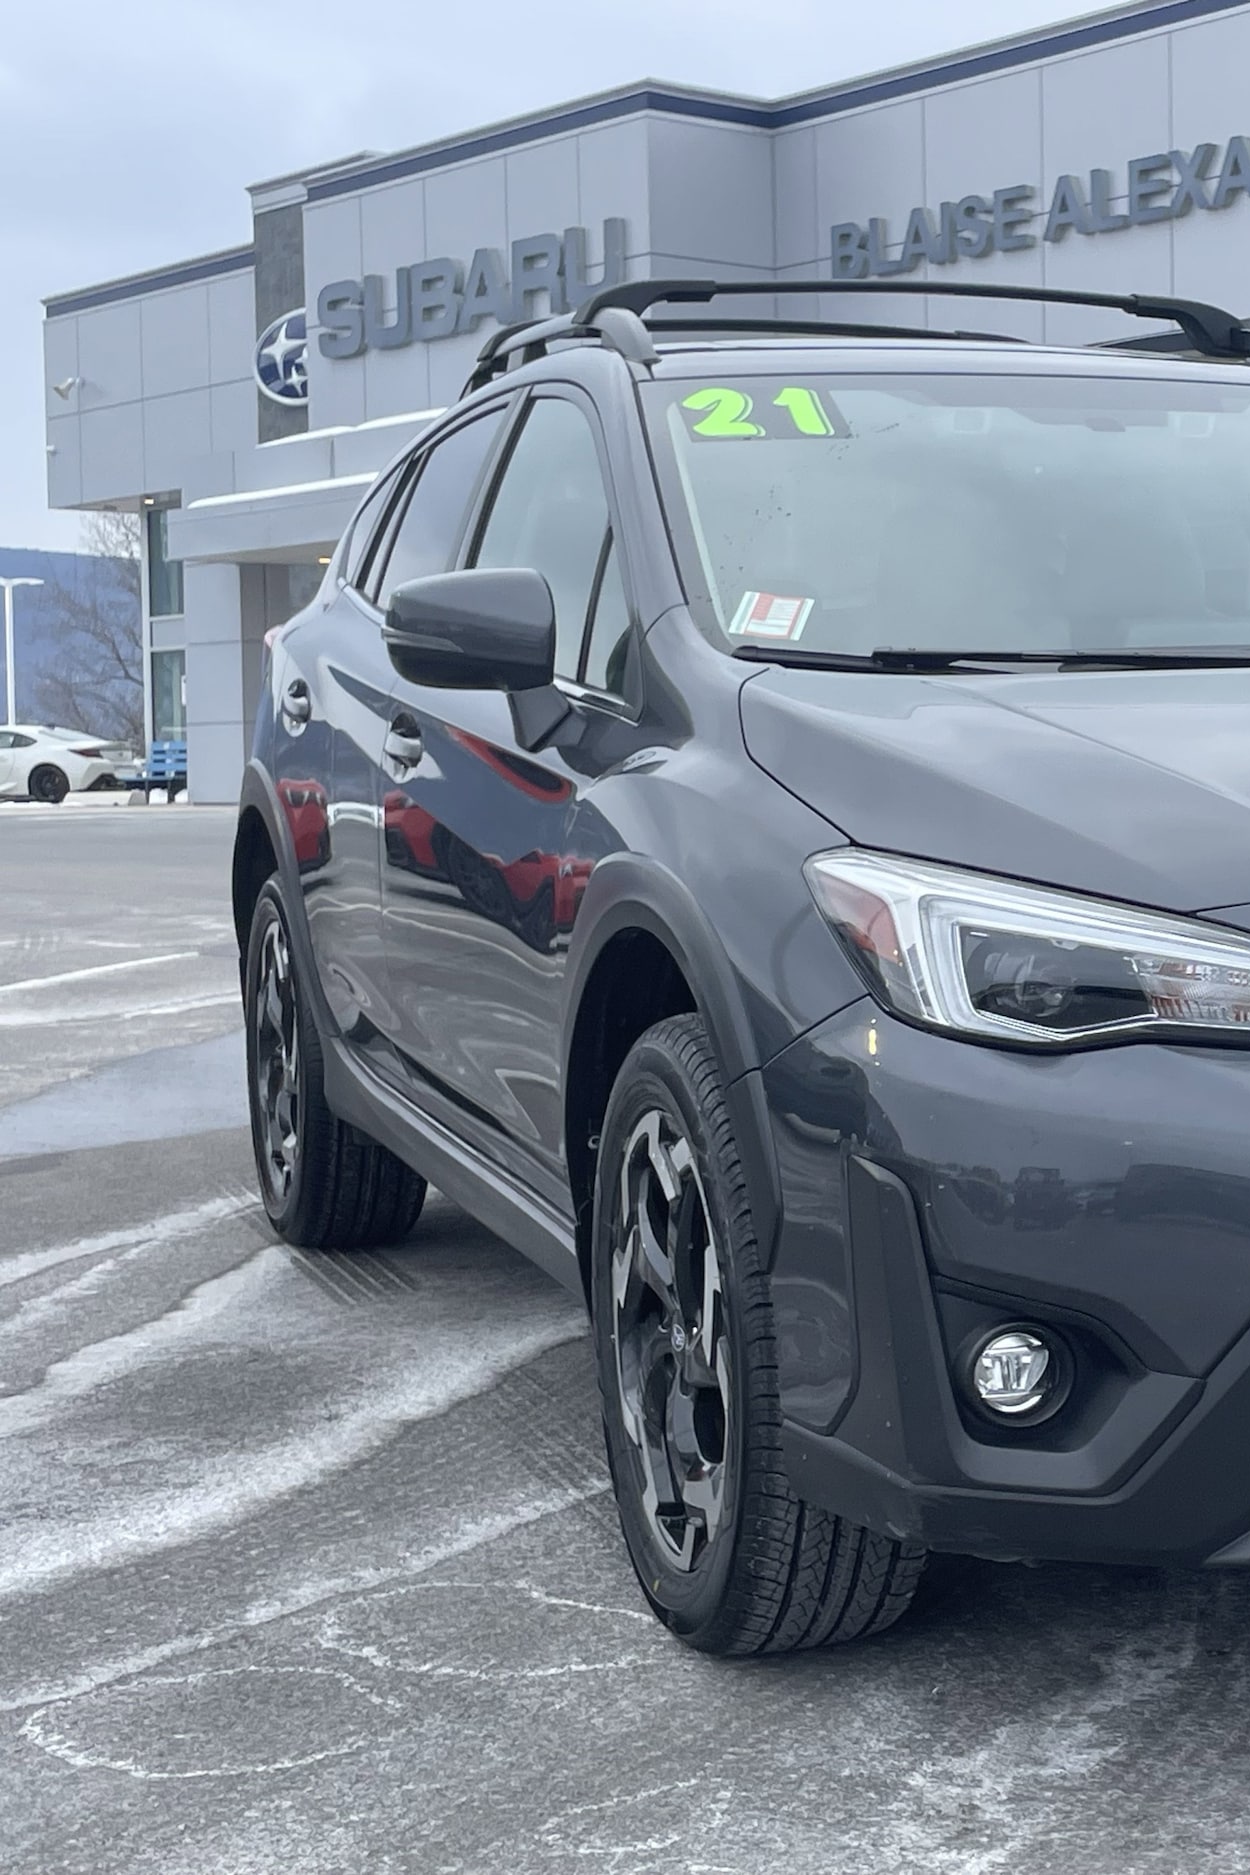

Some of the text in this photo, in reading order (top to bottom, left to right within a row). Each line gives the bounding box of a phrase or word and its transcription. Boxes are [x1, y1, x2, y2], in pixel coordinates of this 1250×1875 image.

[831, 185, 1036, 280] BLAISE
[317, 217, 629, 360] SUBARU
[682, 387, 835, 437] 21
